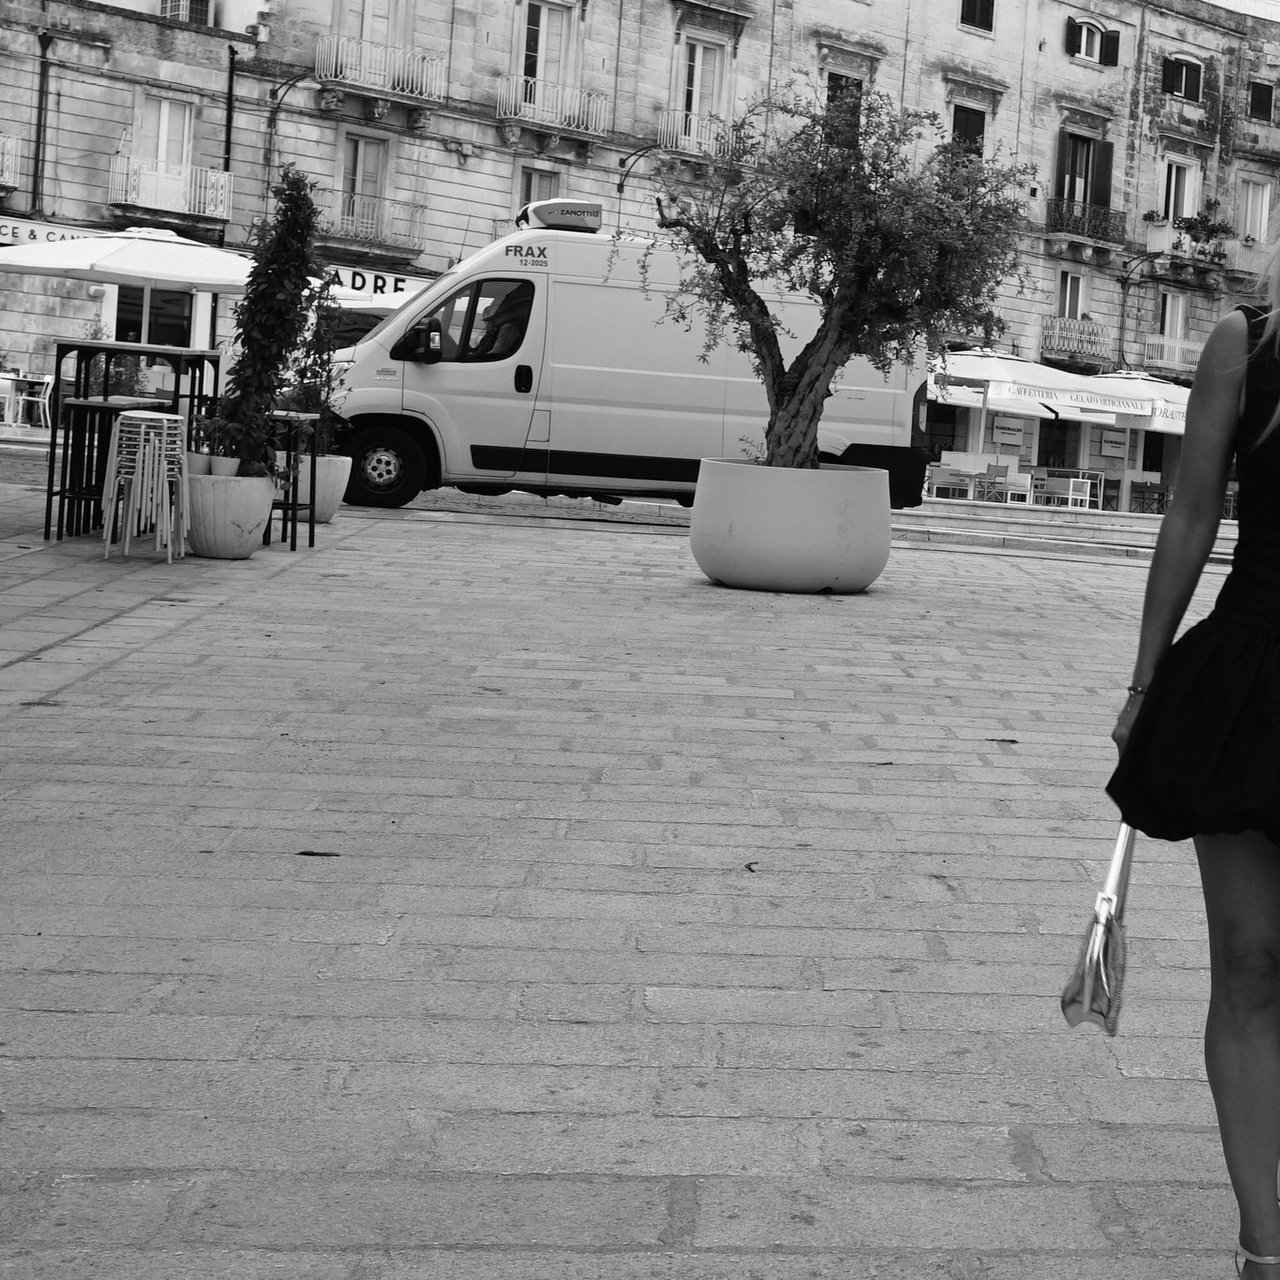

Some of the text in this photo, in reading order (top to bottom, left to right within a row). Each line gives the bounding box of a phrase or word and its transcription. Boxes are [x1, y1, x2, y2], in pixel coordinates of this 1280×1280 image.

[28, 228, 38, 240] &
[505, 245, 548, 259] FRAX
[519, 259, 549, 267] 12-2025
[1008, 385, 1059, 401] CAFFETTERIA
[1070, 394, 1099, 405] GELATO
